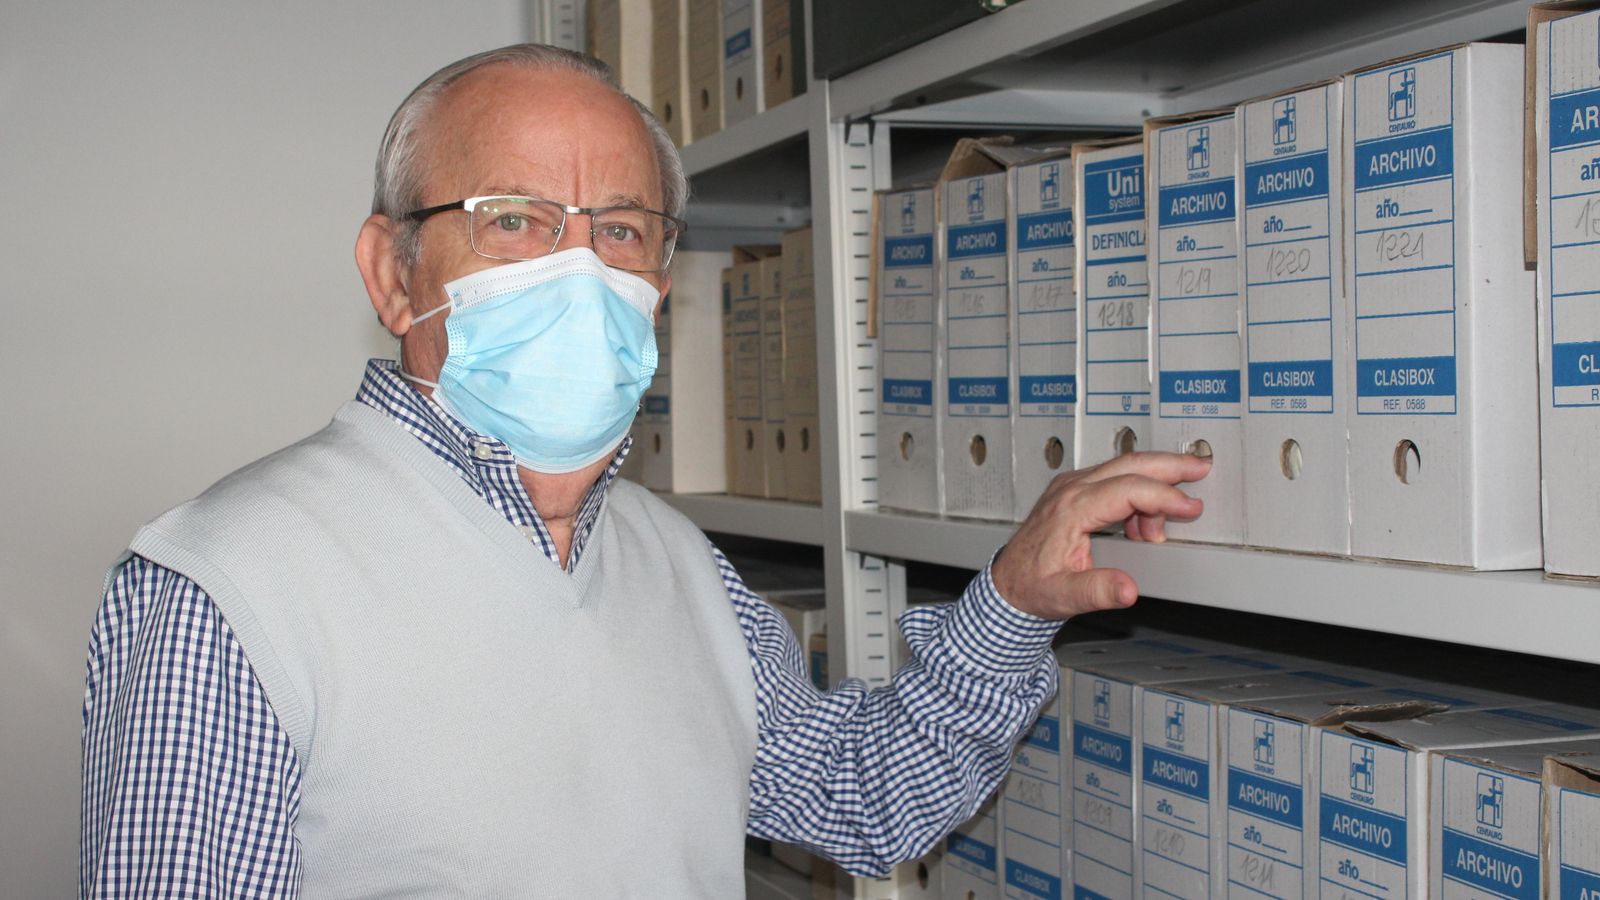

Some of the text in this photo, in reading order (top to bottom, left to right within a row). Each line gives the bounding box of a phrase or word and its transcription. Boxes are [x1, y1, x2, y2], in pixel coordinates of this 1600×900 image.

[1389, 121, 1416, 133] CENTAURO
[1369, 145, 1436, 176] ARCHIVO
[1580, 158, 1600, 181] añ
[1107, 168, 1140, 197] Uni
[1257, 167, 1314, 194] ARCHIVO
[1109, 195, 1140, 212] system
[1171, 192, 1227, 216] ARCHIVO
[1376, 200, 1399, 219] año
[1027, 220, 1073, 241] ARCHIVO
[1263, 216, 1283, 234] año
[955, 232, 997, 251] ARCHIVO
[1176, 236, 1196, 252] año
[1376, 231, 1424, 263] 1221
[891, 244, 925, 260] ARCHIVO
[1032, 258, 1049, 273] año
[1266, 248, 1311, 281] 1220
[1107, 271, 1127, 288] año
[1176, 266, 1212, 296] 1219
[1098, 301, 1134, 327] 1218
[1174, 378, 1227, 395] CLASIBOX
[1263, 371, 1315, 388] CLASIBOX
[1375, 368, 1435, 386] CLASIBOX
[959, 384, 997, 398] CLASIBOX
[1031, 382, 1074, 396] CLASIBOX
[1290, 398, 1308, 409] 0588
[1406, 399, 1426, 410] 0588
[1082, 736, 1122, 762] ARCHIVO
[1085, 772, 1100, 788] año
[1152, 760, 1198, 788] ARCHIVO
[1156, 798, 1173, 816] año
[1238, 784, 1290, 814] ARCHIVO
[1243, 825, 1262, 845] año
[1332, 813, 1392, 848] ARCHIVO
[1476, 826, 1503, 841] CENTAURO
[1338, 859, 1359, 880] año
[1456, 848, 1523, 889] ARCHIVO
